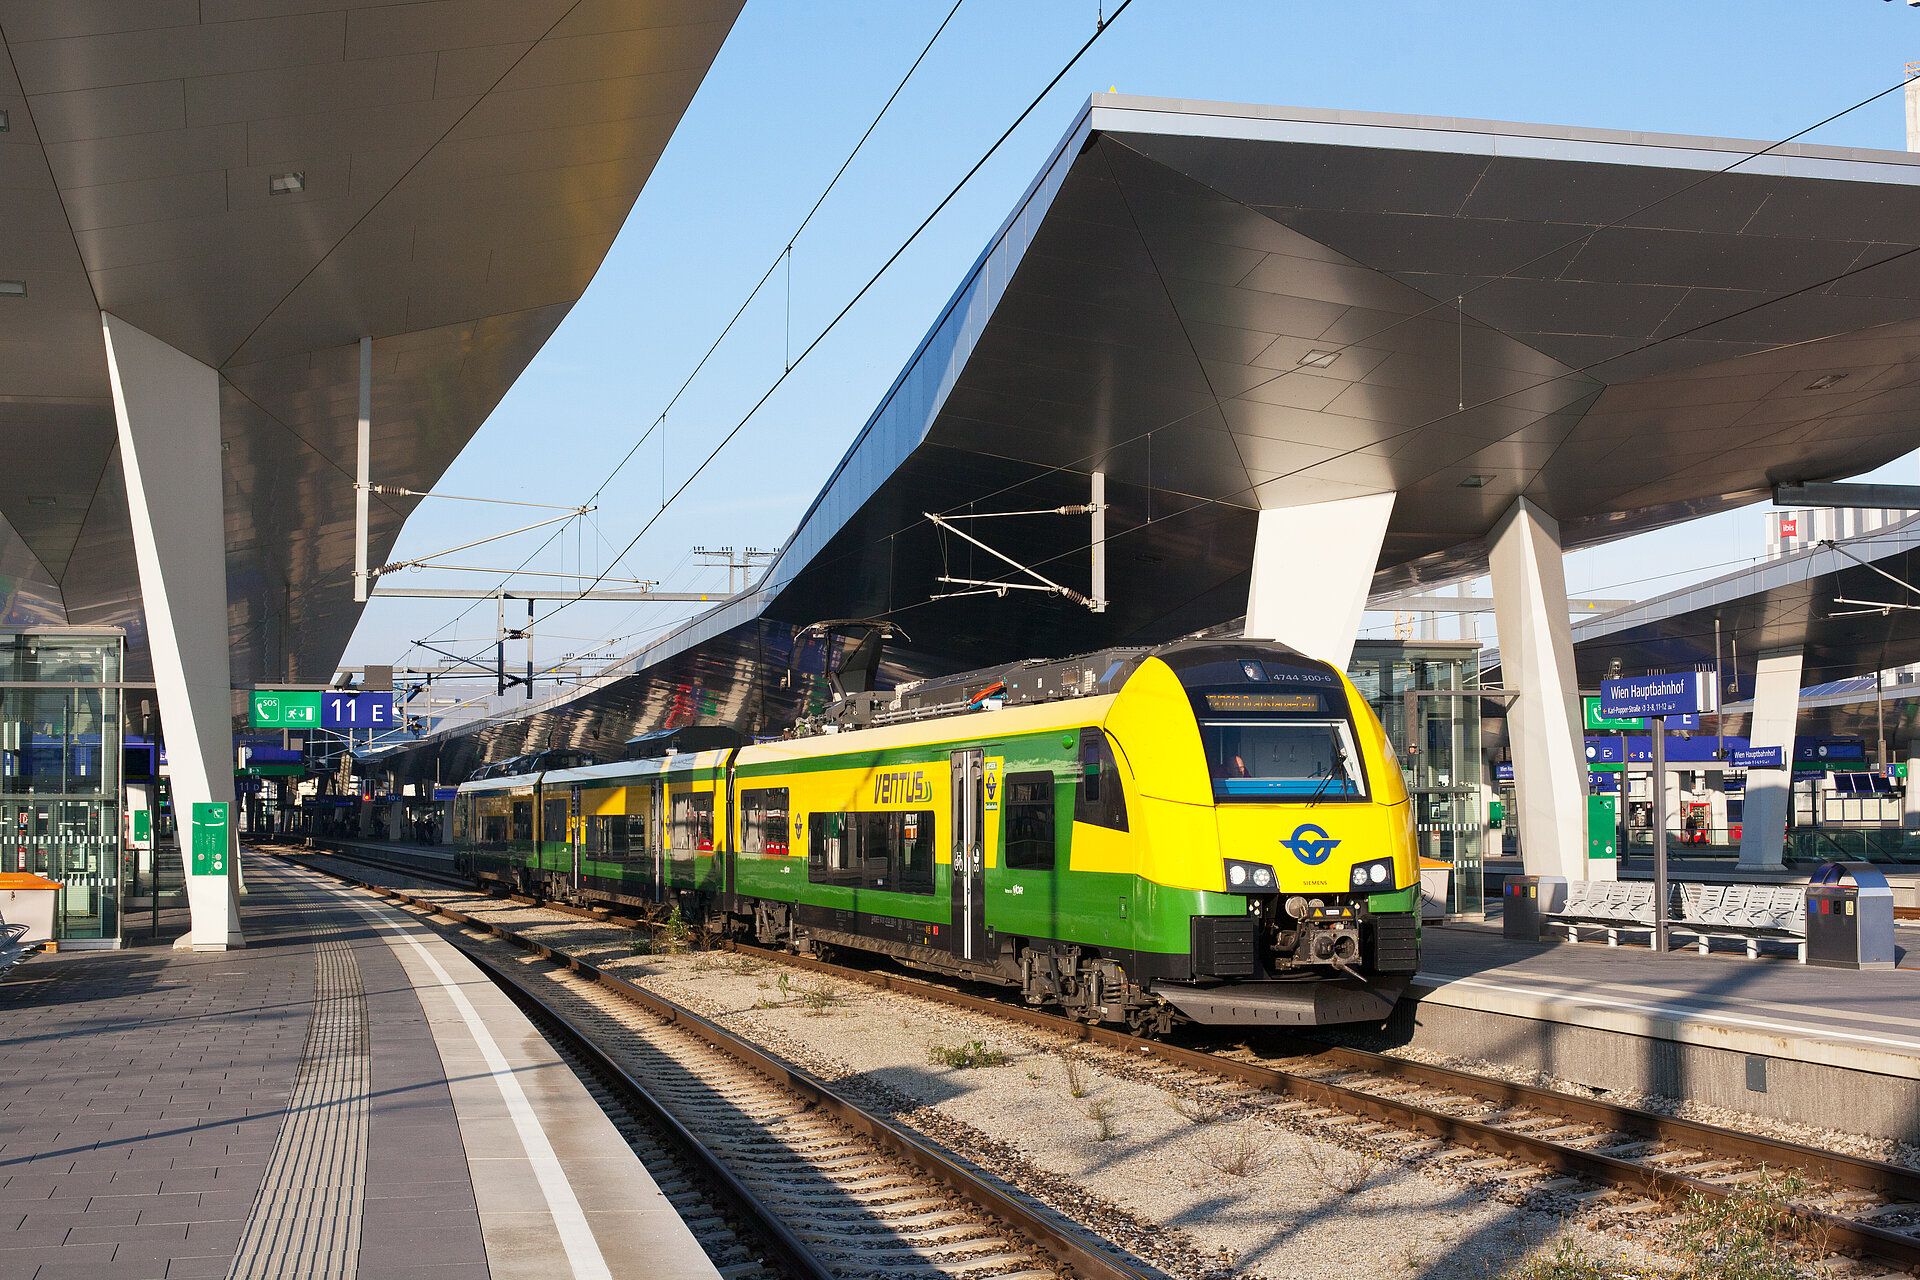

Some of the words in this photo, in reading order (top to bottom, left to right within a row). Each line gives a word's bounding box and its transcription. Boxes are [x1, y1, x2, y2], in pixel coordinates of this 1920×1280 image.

[1782, 524, 1795, 532] ibis
[1302, 674, 1332, 682] 300-6
[1611, 686, 1629, 700] Wien
[1631, 679, 1684, 700] Hauptbahnhof
[263, 699, 278, 707] SOS
[331, 698, 356, 722] 11
[372, 704, 384, 722] E
[1682, 713, 1692, 725] E
[1638, 751, 1645, 759] 8
[1734, 751, 1745, 759] Wien
[1745, 748, 1776, 759] Hauptbahnhof
[1588, 774, 1594, 783] 6
[239, 782, 249, 791] 11
